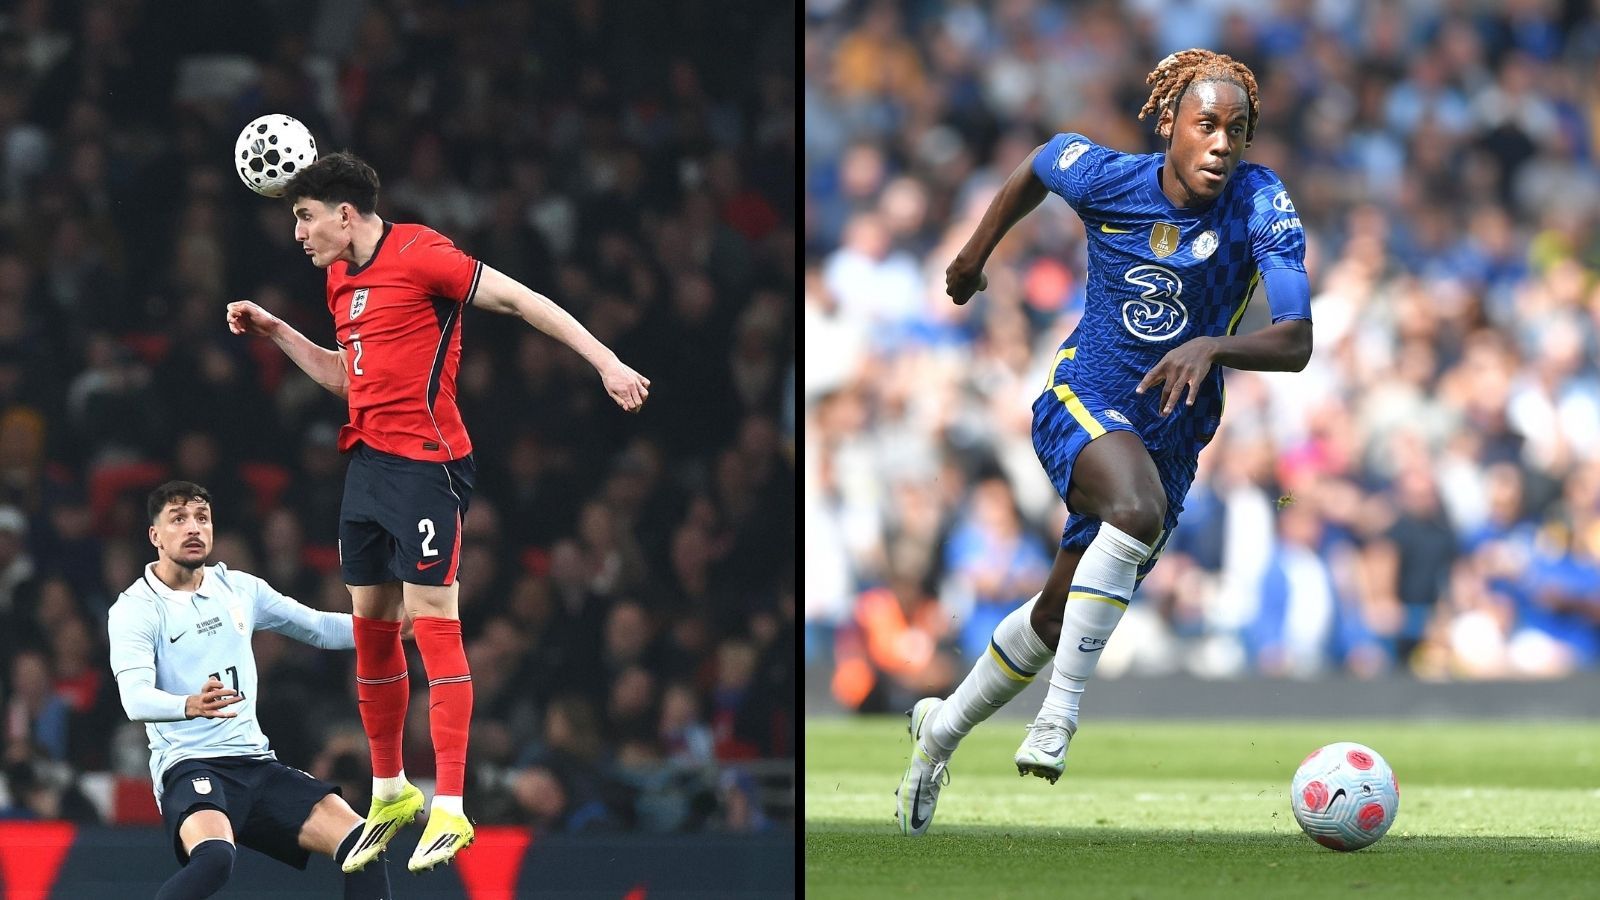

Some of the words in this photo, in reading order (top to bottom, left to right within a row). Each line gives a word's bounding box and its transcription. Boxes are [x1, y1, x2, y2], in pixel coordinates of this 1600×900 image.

[1156, 243, 1169, 251] FIFA
[351, 335, 364, 376] 2
[417, 518, 439, 557] 2
